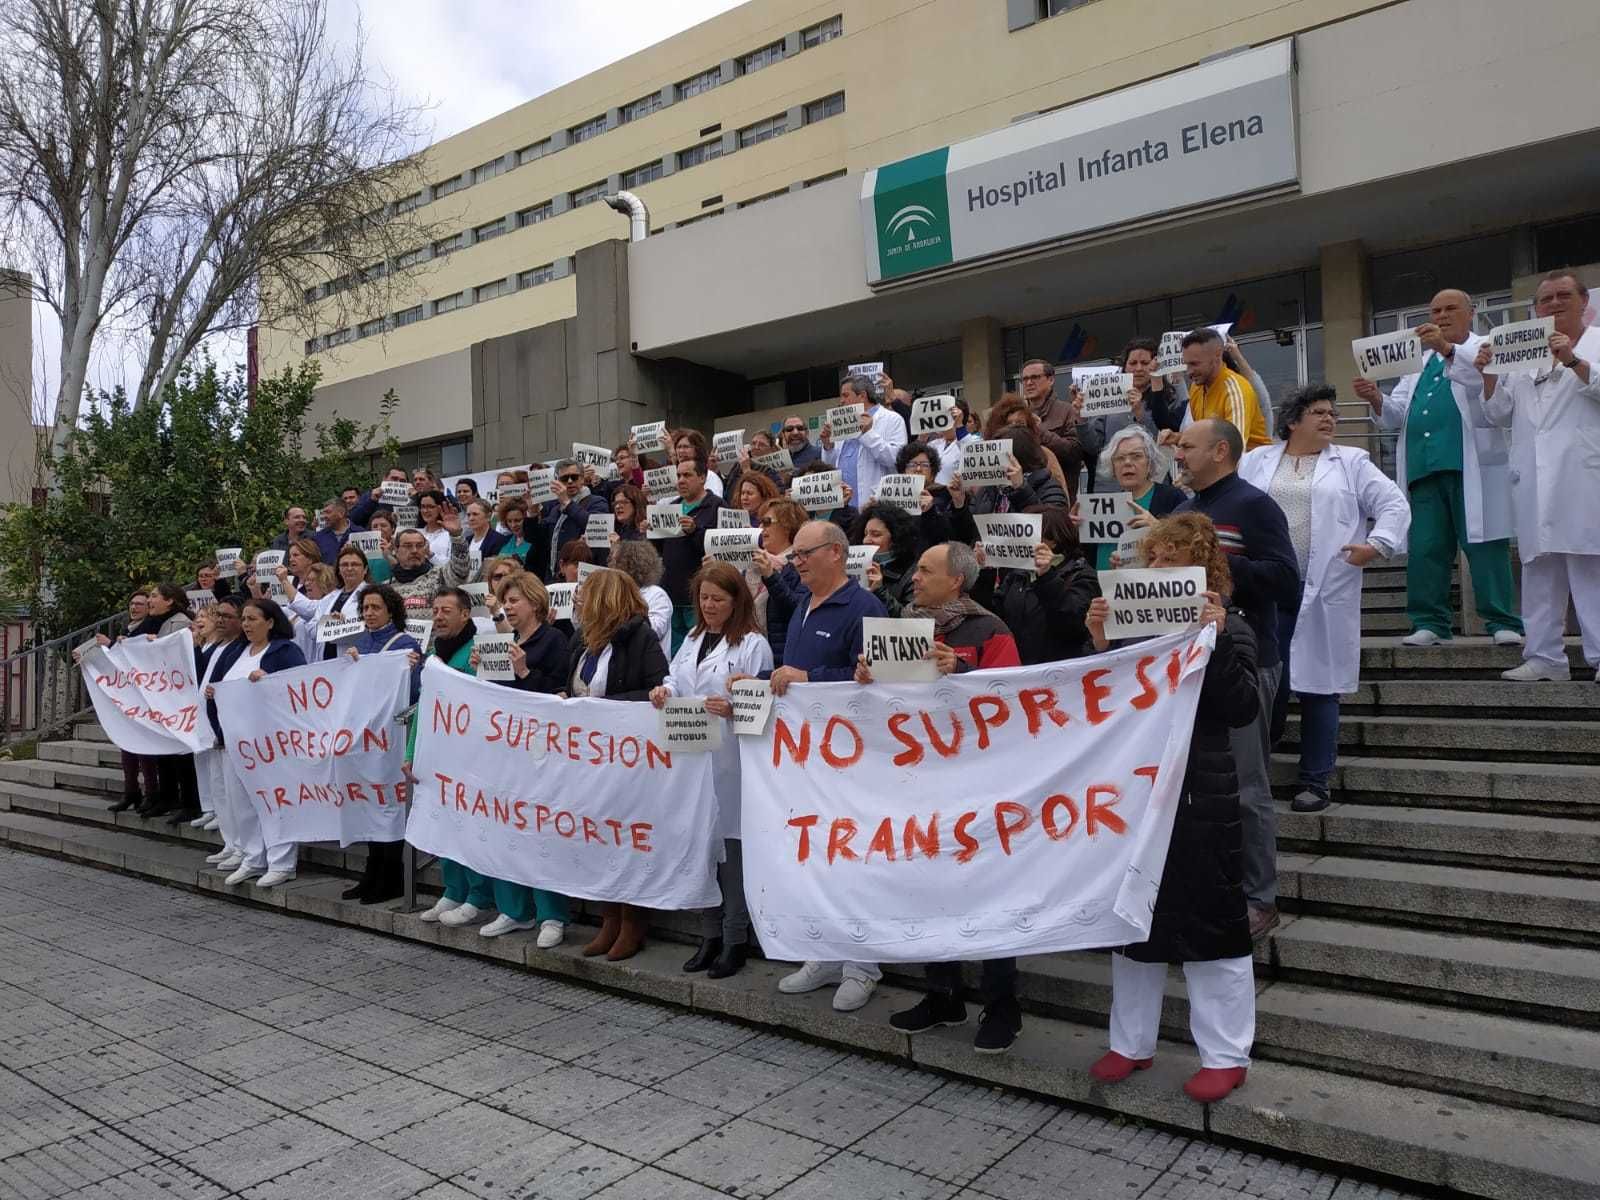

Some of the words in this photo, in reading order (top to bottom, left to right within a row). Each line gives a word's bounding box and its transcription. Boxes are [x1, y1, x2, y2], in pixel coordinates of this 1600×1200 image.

[967, 162, 1066, 212] Hospital
[1079, 138, 1169, 183] Infanta
[1181, 114, 1264, 155] Elena
[1494, 334, 1504, 346] NO
[1495, 346, 1548, 365] TRANSPORTE
[1089, 389, 1101, 399] NO
[1104, 388, 1110, 398] A
[1112, 386, 1122, 396] LA
[920, 399, 942, 414] 7H
[832, 418, 843, 426] NO
[849, 416, 858, 424] LA
[920, 414, 950, 430] NO
[976, 444, 984, 452] ES
[964, 457, 976, 468] NO
[979, 456, 985, 466] A
[988, 455, 1000, 466] LA
[800, 485, 811, 495] NO
[814, 485, 819, 493] A
[822, 483, 832, 492] LA
[881, 487, 892, 496] NO
[895, 488, 900, 496] A
[903, 488, 913, 496] LA
[1089, 497, 1115, 515] 7H
[986, 523, 1034, 538] ANDANDO
[1089, 520, 1124, 538] NO
[711, 536, 718, 546] NO
[985, 544, 996, 557] NO
[996, 544, 1007, 558] SE
[1008, 545, 1035, 558] PUEDE
[1114, 579, 1196, 600] ANDANDO
[1114, 609, 1133, 625] NO
[1136, 608, 1153, 623] SE
[1156, 606, 1198, 623] PUEDE
[479, 642, 508, 654] ANDANDO
[287, 676, 334, 715] NO
[433, 698, 470, 736] NO
[486, 710, 673, 768] SUPRESION
[668, 733, 707, 741] AUTOBUS
[772, 713, 864, 769] NO
[238, 727, 389, 771] SUPRESION
[435, 773, 655, 852] TRANSPORTE
